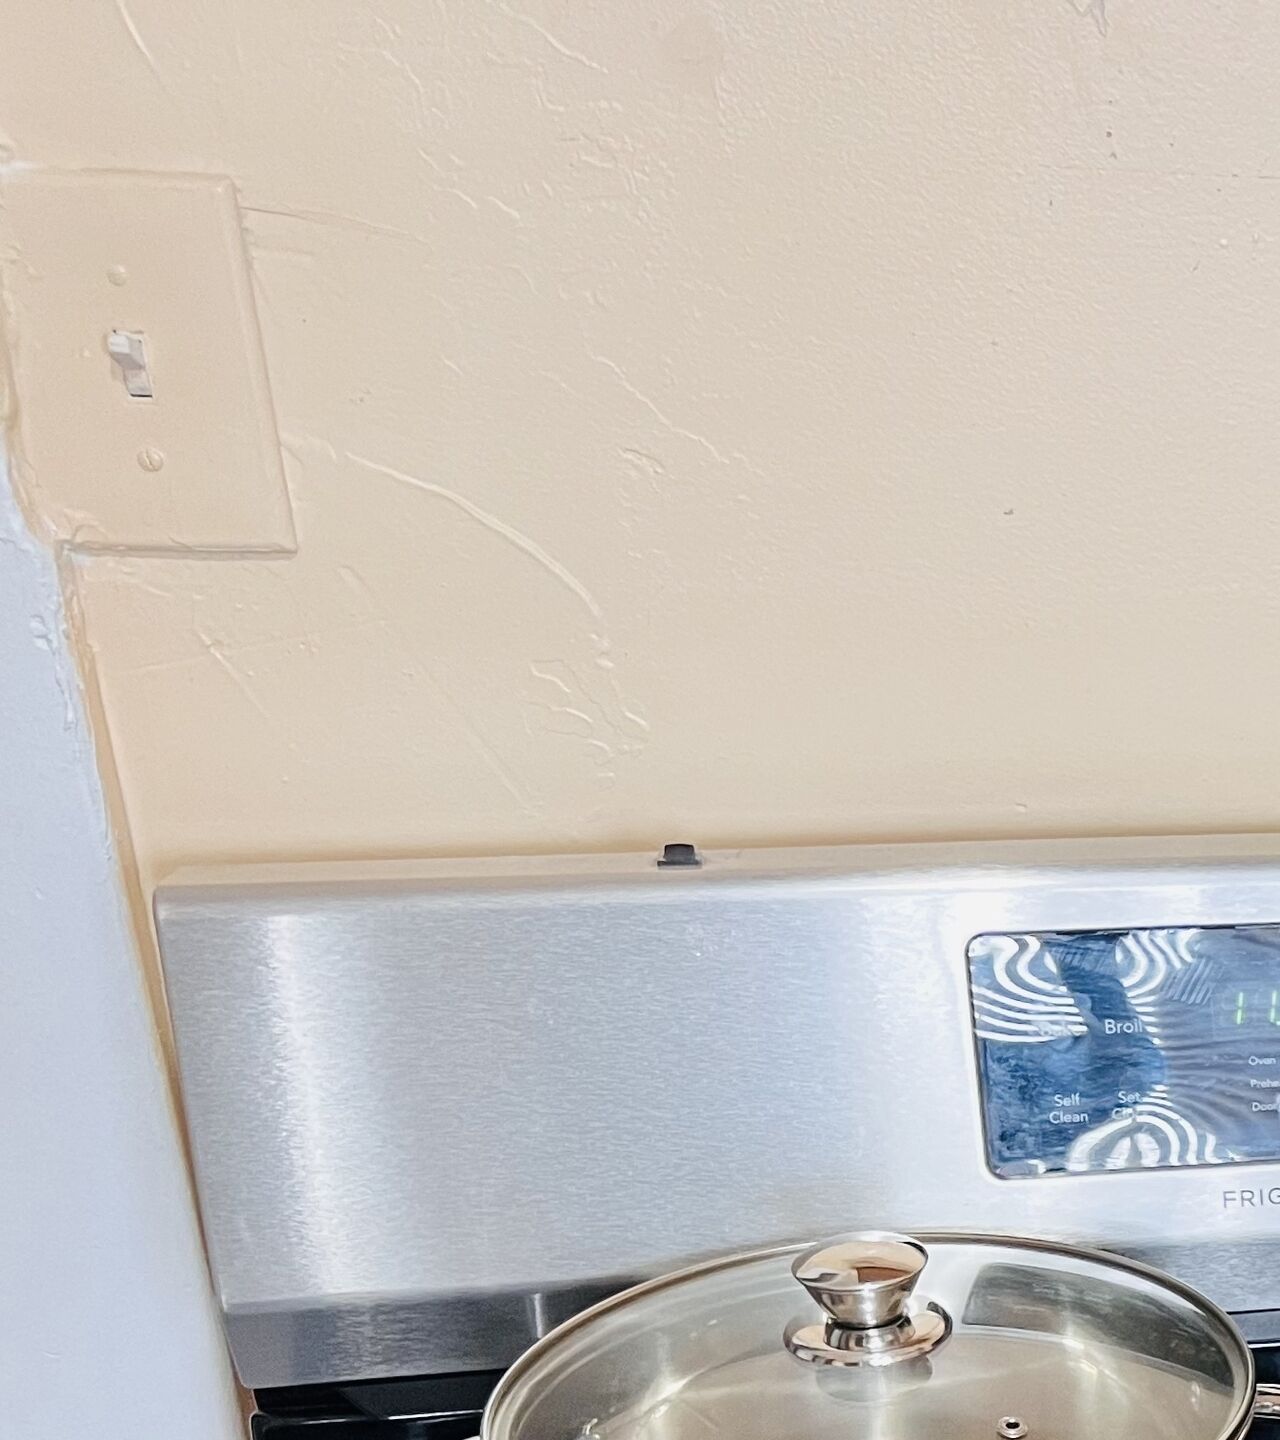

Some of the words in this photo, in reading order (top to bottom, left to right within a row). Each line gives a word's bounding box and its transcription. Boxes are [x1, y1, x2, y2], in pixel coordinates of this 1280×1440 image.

[1104, 1018, 1143, 1035] Broil
[1248, 1055, 1277, 1066] Oven
[1054, 1092, 1081, 1108] Self
[1117, 1090, 1142, 1104] Set
[1049, 1111, 1089, 1125] Clean
